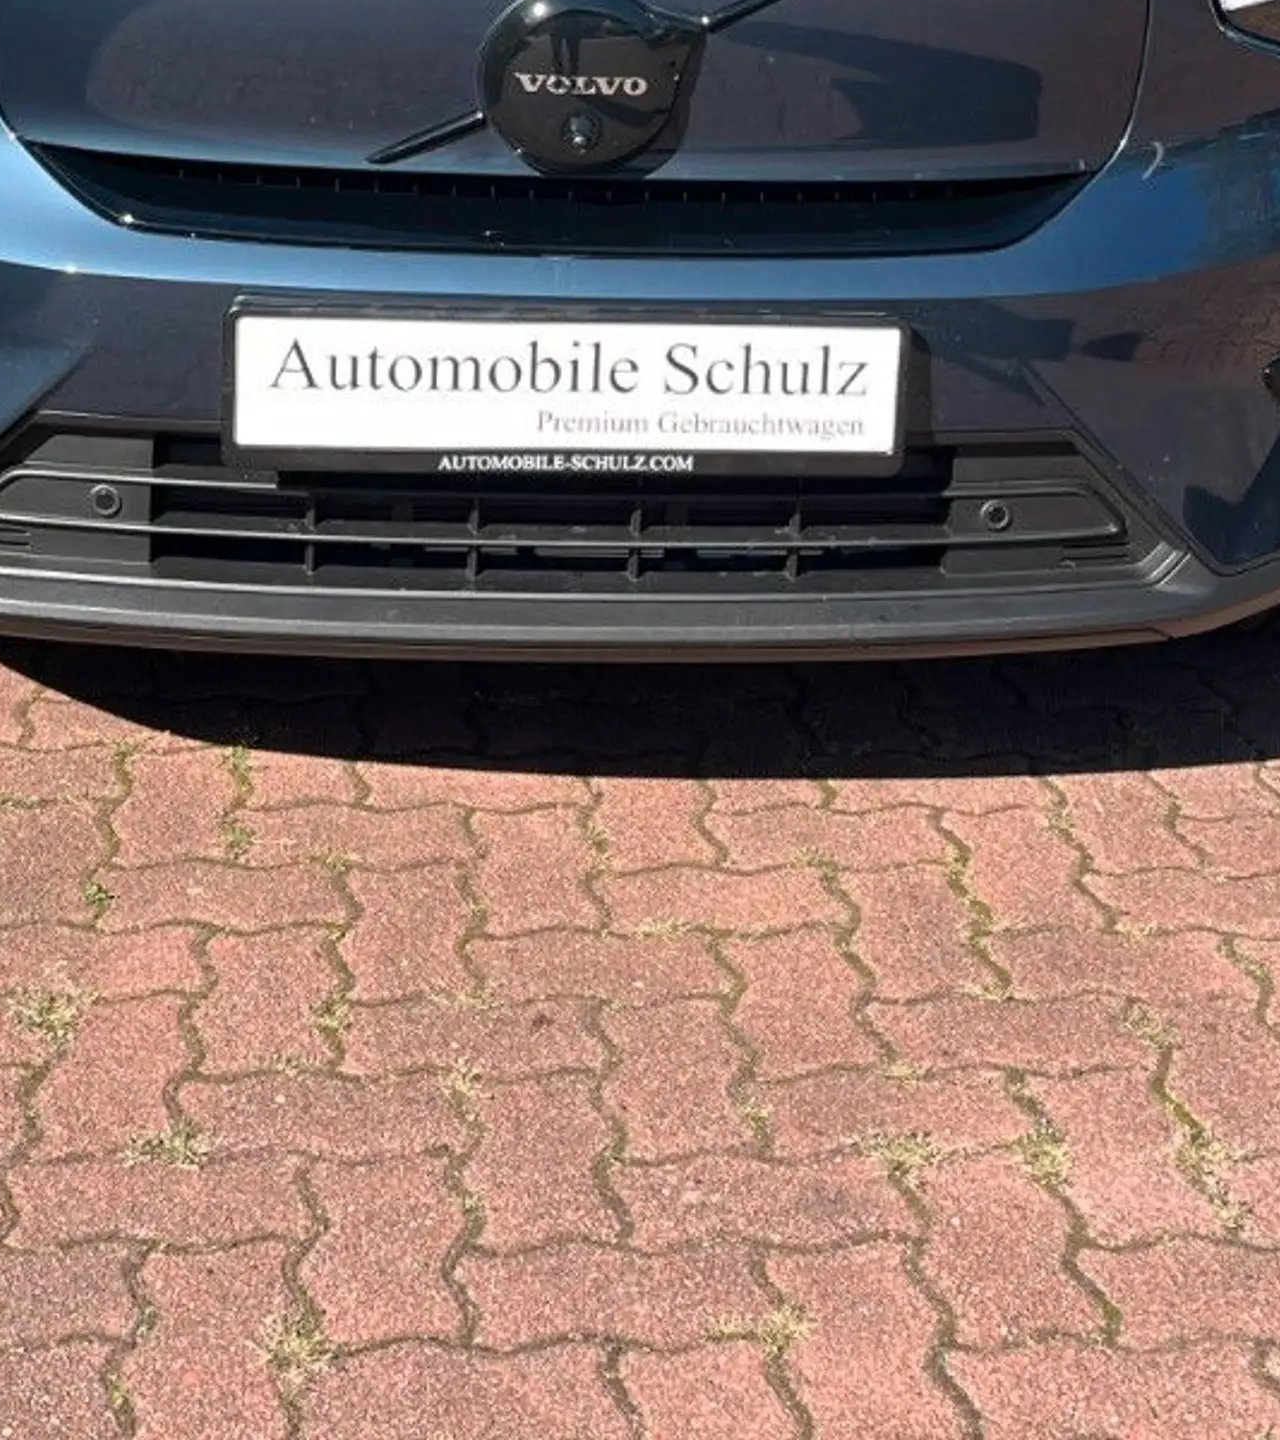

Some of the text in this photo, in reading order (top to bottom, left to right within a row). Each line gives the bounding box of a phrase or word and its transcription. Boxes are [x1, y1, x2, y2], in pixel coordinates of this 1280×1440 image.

[515, 72, 648, 96] VOLVO
[270, 338, 867, 397] Automobile Schulz
[536, 410, 865, 440] Premium Gebrauchtwagen
[438, 455, 694, 472] AUTOMOBILE-SCHULZ.COM
